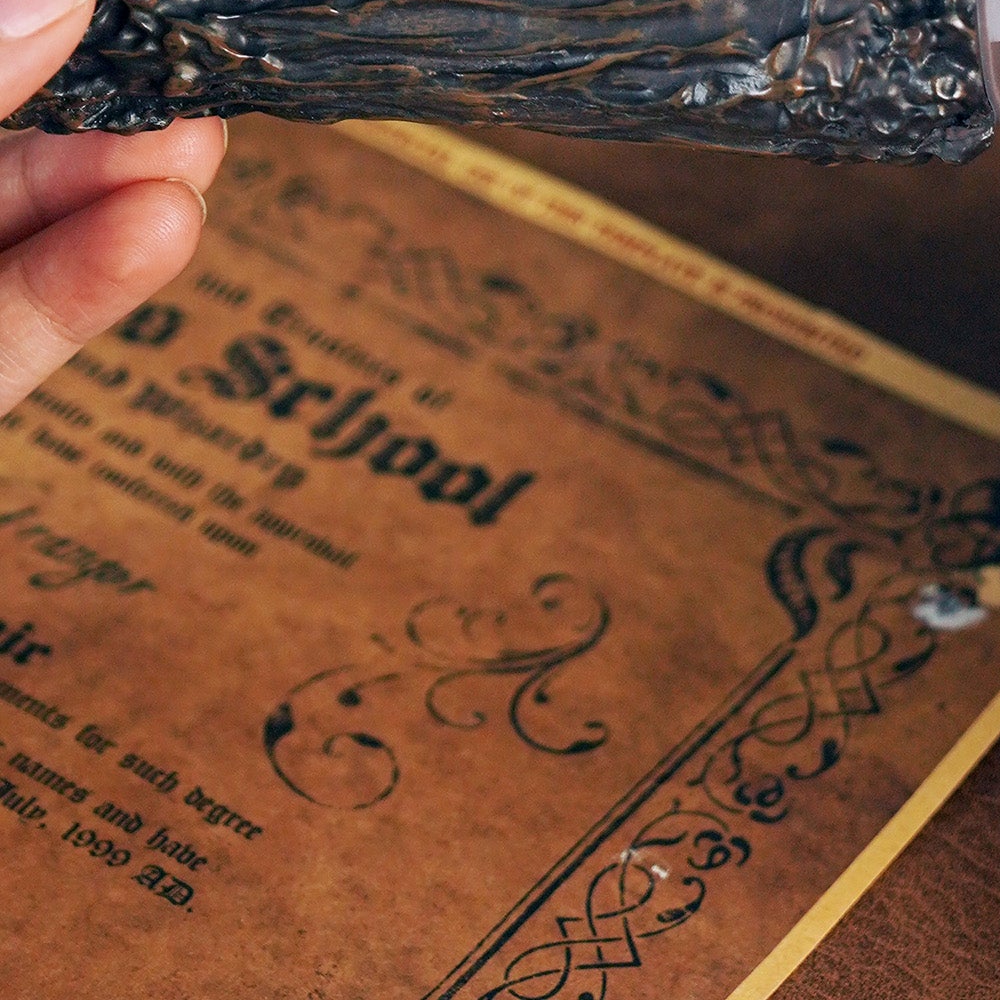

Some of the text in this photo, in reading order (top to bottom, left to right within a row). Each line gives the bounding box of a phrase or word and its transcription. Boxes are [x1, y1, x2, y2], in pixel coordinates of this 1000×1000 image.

[177, 333, 537, 527] School
[8, 752, 209, 872] names and have
[75, 723, 117, 756] for
[118, 751, 181, 794] such
[183, 785, 265, 842] degree
[61, 820, 133, 868] 1999
[130, 863, 195, 914] AD.
